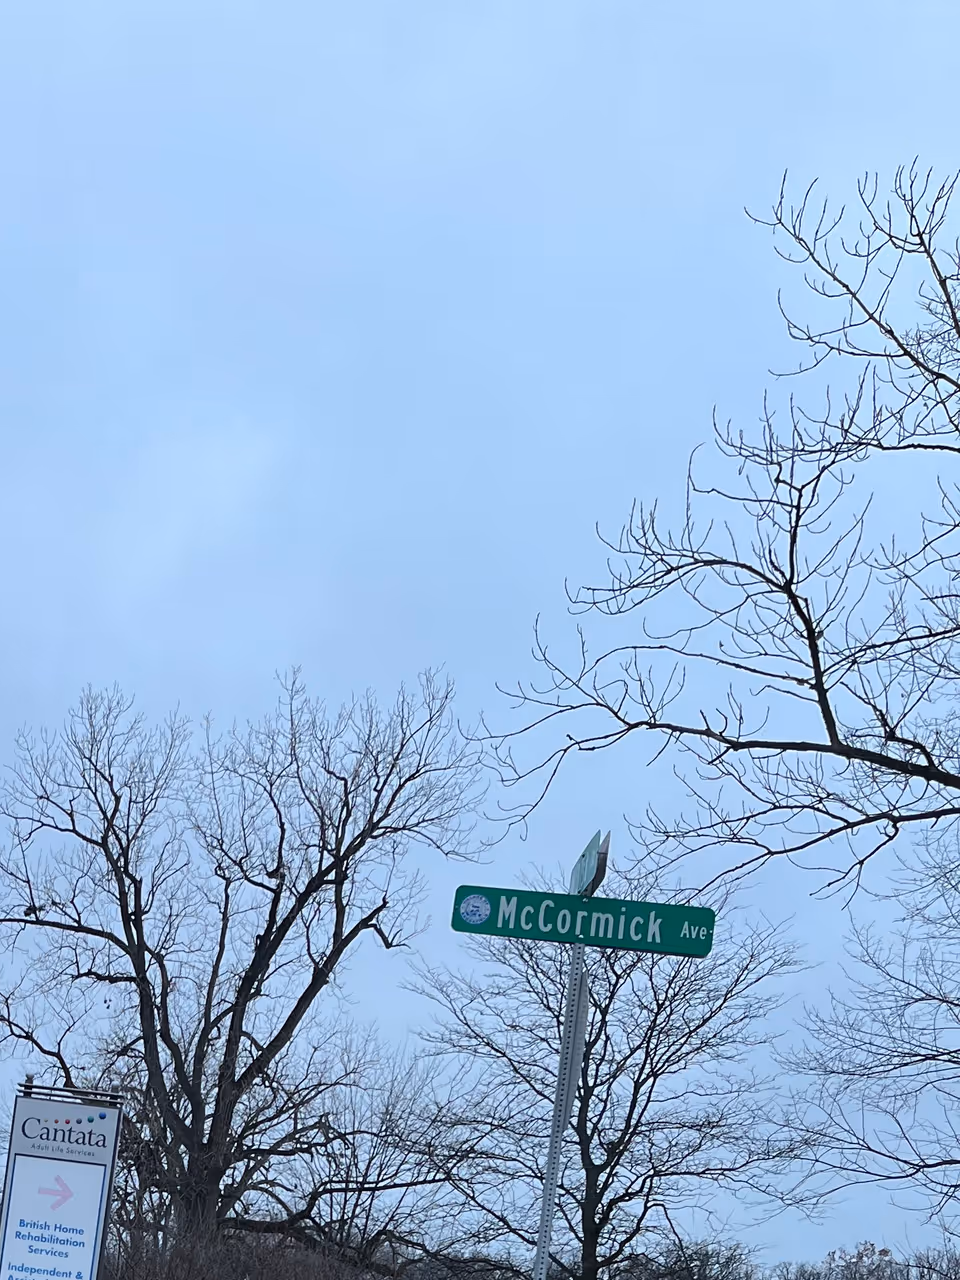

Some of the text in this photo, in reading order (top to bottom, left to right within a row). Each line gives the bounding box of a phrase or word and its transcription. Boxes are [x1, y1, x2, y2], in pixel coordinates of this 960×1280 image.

[496, 895, 663, 944] McCormick
[680, 921, 707, 940] Ave
[21, 1117, 107, 1149] Cantata
[31, 1143, 95, 1157] Adult Life Services
[19, 1219, 84, 1235] British Home
[15, 1231, 85, 1248] Rehabilitation
[28, 1245, 69, 1258] Services
[7, 1262, 84, 1280] Independent &
